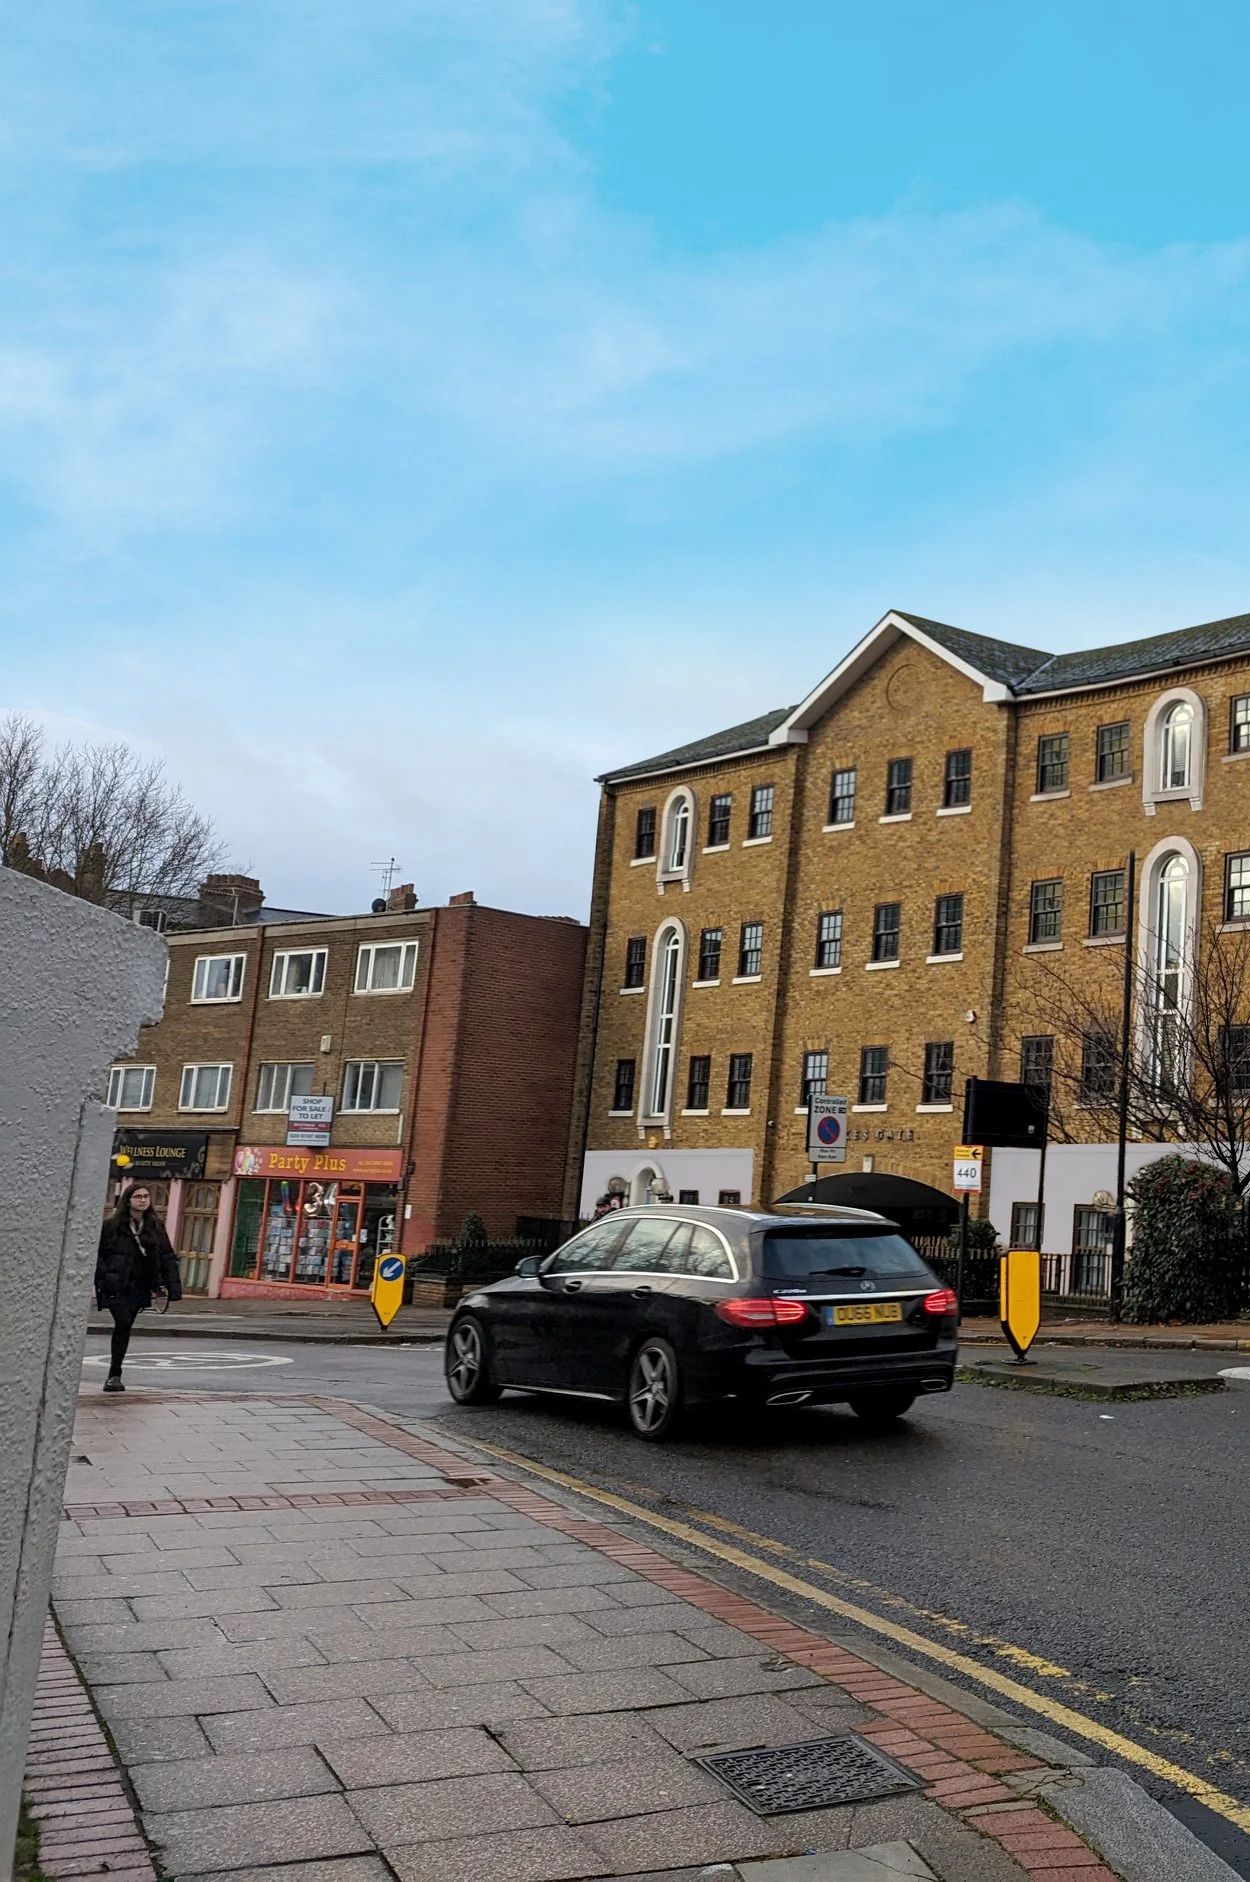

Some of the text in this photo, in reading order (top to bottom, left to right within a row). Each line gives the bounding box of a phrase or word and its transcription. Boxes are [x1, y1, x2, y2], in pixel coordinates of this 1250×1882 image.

[814, 1105, 836, 1114] ZONE
[876, 1129, 914, 1141] GATE
[155, 1146, 187, 1158] LOUNGE
[268, 1153, 347, 1174] Party Plus
[957, 1167, 977, 1178] 440
